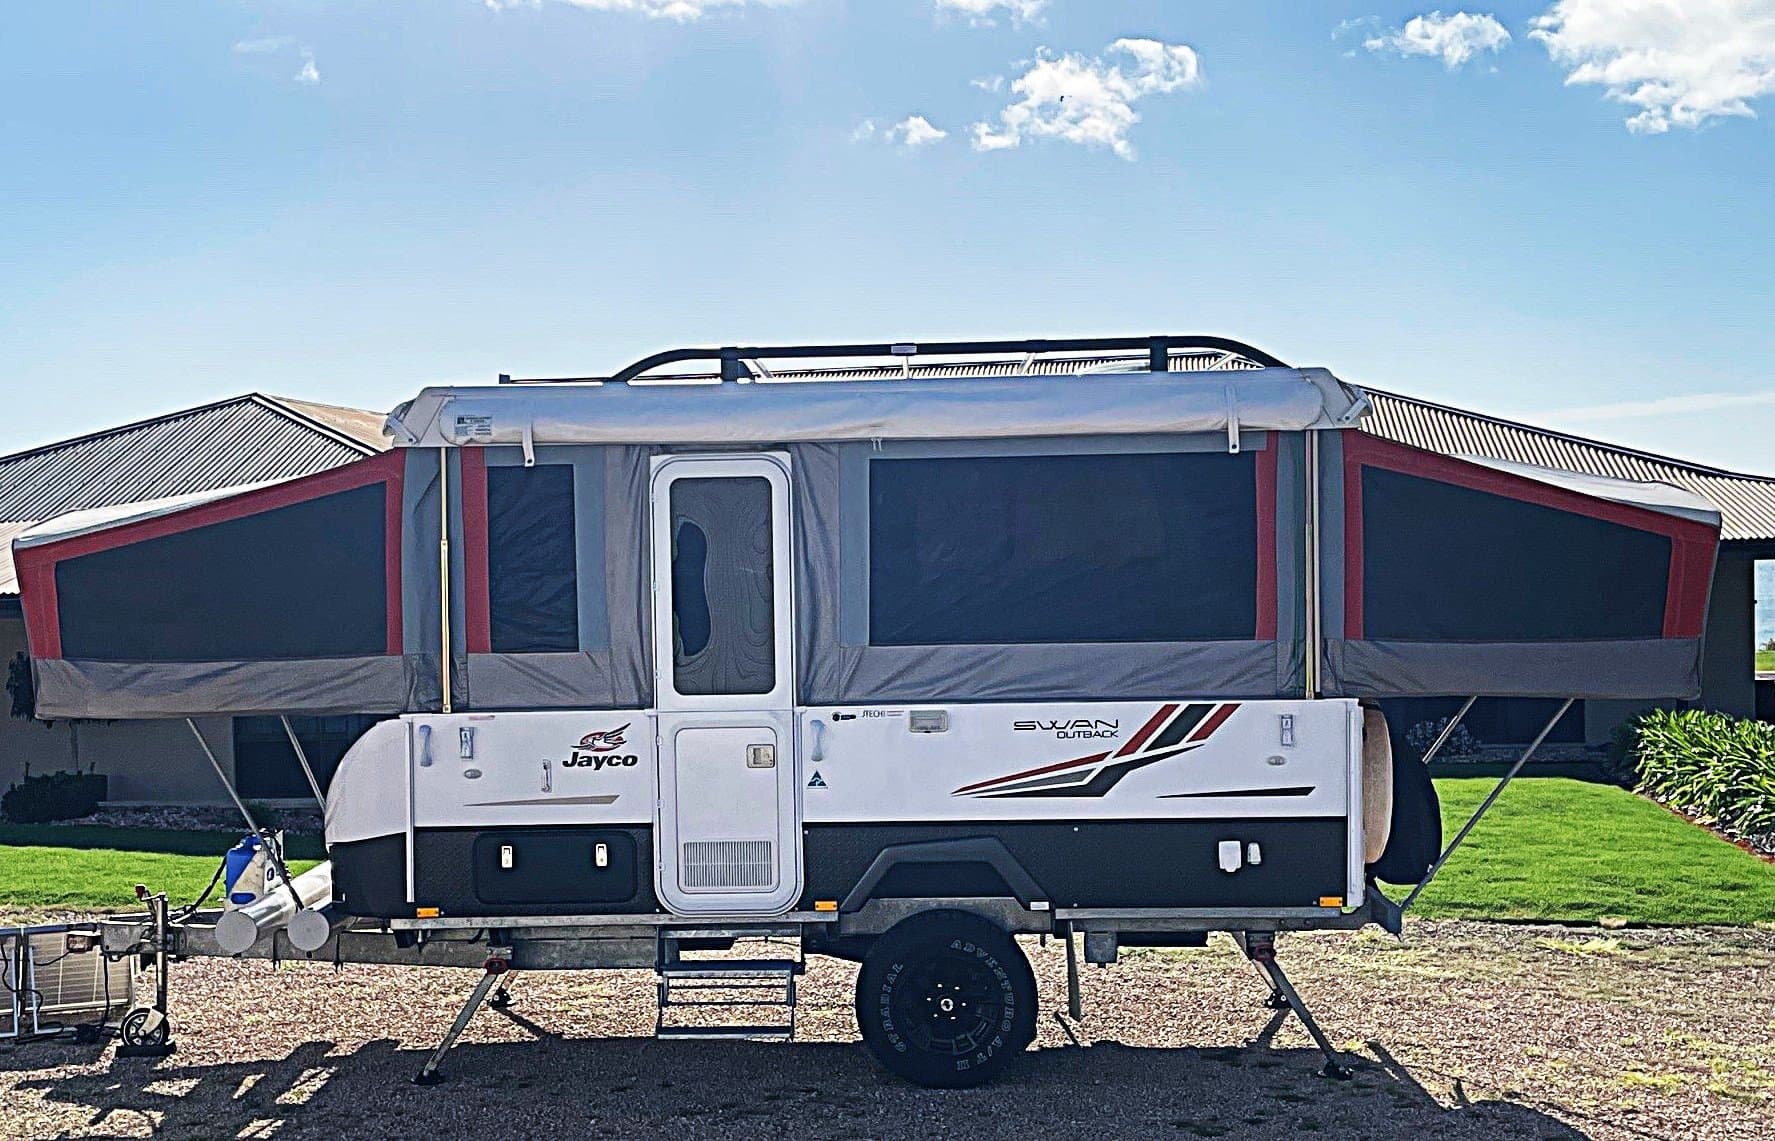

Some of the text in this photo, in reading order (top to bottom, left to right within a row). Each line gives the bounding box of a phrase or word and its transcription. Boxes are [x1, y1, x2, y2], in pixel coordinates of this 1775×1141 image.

[1013, 719, 1119, 731] SWAN
[1056, 730, 1119, 739] OUTBACK
[562, 751, 638, 771] Jayco
